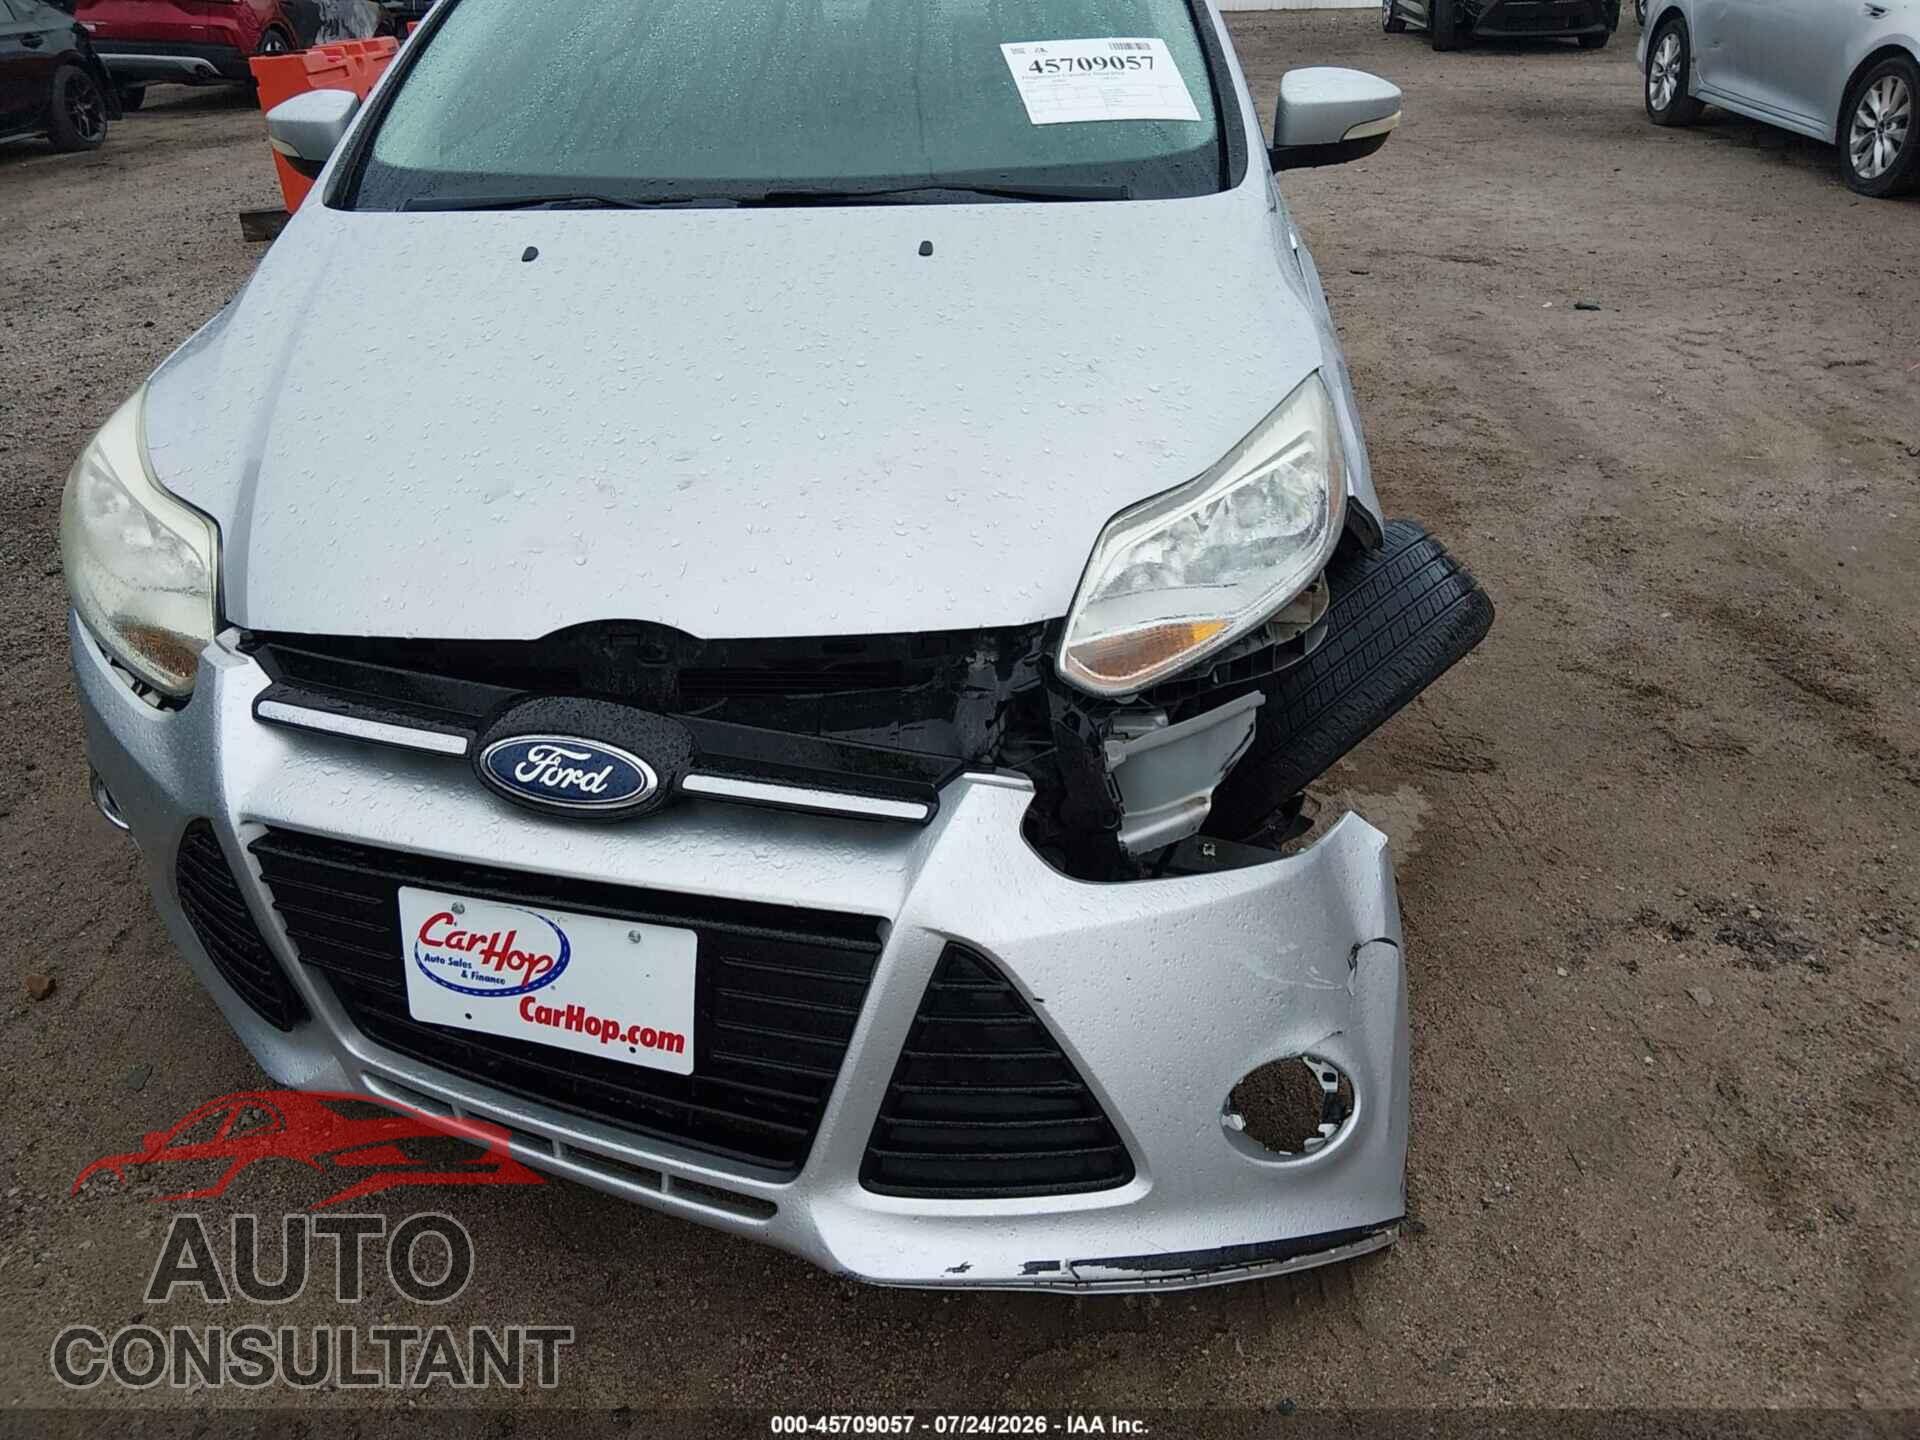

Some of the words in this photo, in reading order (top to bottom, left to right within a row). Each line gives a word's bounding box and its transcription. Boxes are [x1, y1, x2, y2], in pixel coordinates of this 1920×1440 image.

[1028, 56, 1154, 74] 45709057
[514, 745, 613, 793] Ford
[419, 912, 553, 987] CarHop
[424, 953, 445, 964] Auto
[448, 957, 472, 969] Sales
[461, 970, 468, 978] &
[471, 971, 506, 985] Finance
[519, 996, 685, 1054] CarHop.com
